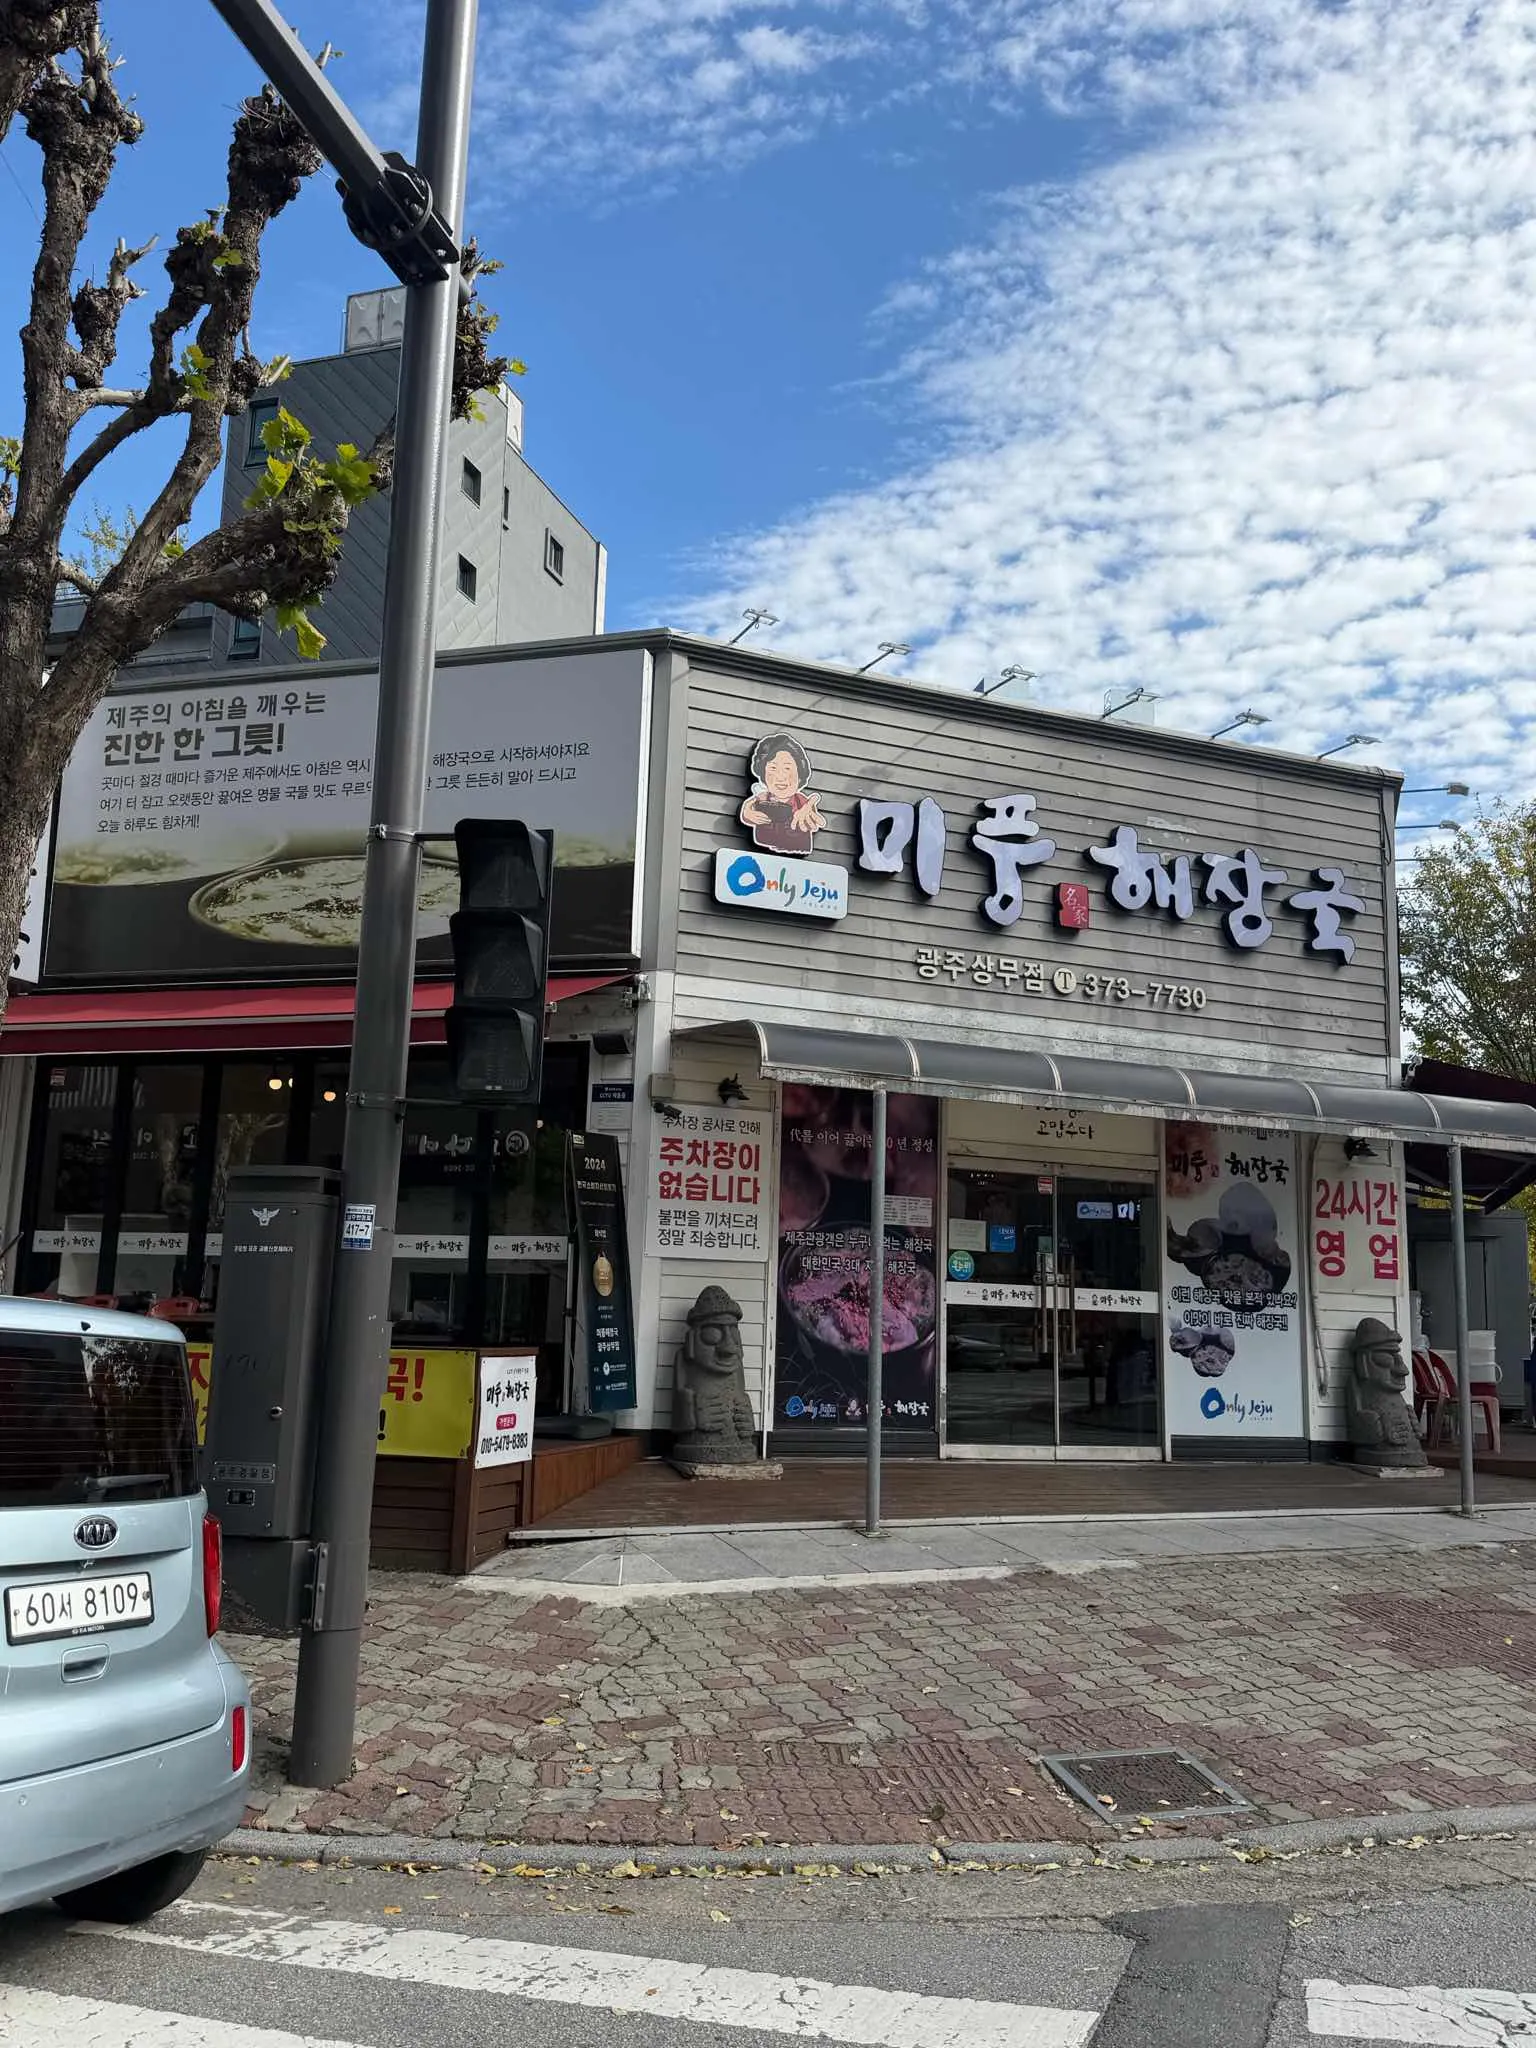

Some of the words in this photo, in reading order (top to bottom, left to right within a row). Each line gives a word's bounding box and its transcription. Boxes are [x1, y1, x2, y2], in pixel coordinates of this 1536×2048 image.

[105, 703, 171, 728] 제주의
[181, 696, 247, 723] 아침을
[257, 691, 325, 717] 깨우는
[104, 731, 164, 766] 진한
[173, 728, 204, 761] 한
[212, 723, 285, 757] 그릇!
[139, 772, 161, 787] 절경
[165, 769, 201, 785] 때마다
[203, 767, 238, 784] 즐거운
[242, 763, 301, 780] 제주에서도
[305, 761, 342, 776] 아침은
[433, 750, 495, 767] 해장국으로
[499, 741, 591, 763] 시작하셔야지요
[100, 796, 122, 811] 여기
[125, 796, 137, 810] 터
[140, 795, 164, 809] 잡고
[167, 791, 214, 807] 오랫동안
[217, 789, 253, 806] 끓여온
[257, 788, 281, 803] 명물
[284, 786, 309, 800] 국물
[312, 783, 337, 798] 맛도
[436, 774, 461, 791] 그릇
[465, 771, 503, 787] 든든히
[508, 769, 533, 785] 말아
[537, 767, 577, 783] 드시고
[97, 819, 120, 833] 오늘
[123, 816, 158, 832] 하루도
[162, 814, 200, 830] 힘차게!
[726, 855, 796, 907] Only
[800, 879, 839, 903] Jeju
[857, 793, 1057, 928] 미풍
[1084, 824, 1368, 966] 해장국
[916, 946, 1045, 993] 광주상무점
[1083, 972, 1207, 1009] 373-7730
[662, 1115, 699, 1130] 주차장
[702, 1117, 736, 1133] 공사로
[738, 1120, 761, 1136] 인해
[1036, 1119, 1095, 1140] 고맙수다
[659, 1137, 760, 1172] 주차장이
[817, 1131, 840, 1145] 이어
[911, 1138, 933, 1153] 정성
[584, 1157, 606, 1171] 2024
[1172, 1150, 1208, 1184] 미풍
[1224, 1151, 1290, 1185] 해장국
[658, 1170, 761, 1205] 없습니다
[1315, 1178, 1399, 1227] 24시간
[657, 1209, 701, 1227] 불편을
[704, 1211, 758, 1231] 끼쳐드려
[657, 1228, 686, 1247] 정말
[689, 1230, 761, 1250] 죄송합니다.
[785, 1230, 845, 1248] 제주관광객은
[904, 1236, 933, 1254] 해장국
[801, 1255, 842, 1272] 대한민국
[844, 1258, 861, 1273] 3대
[887, 1260, 917, 1276] 해장국
[1171, 1286, 1191, 1304] 이런
[1192, 1288, 1221, 1305] 해장국
[1223, 1289, 1243, 1306] 맛을
[1183, 1309, 1212, 1328] 이맛이
[1213, 1311, 1233, 1328] 바로
[505, 1380, 530, 1402] 해장국
[1200, 1387, 1246, 1423] Only
[1248, 1400, 1273, 1417] Jeju
[82, 1523, 114, 1545] KIA
[26, 1591, 73, 1627] 60서
[84, 1582, 139, 1619] 8109
